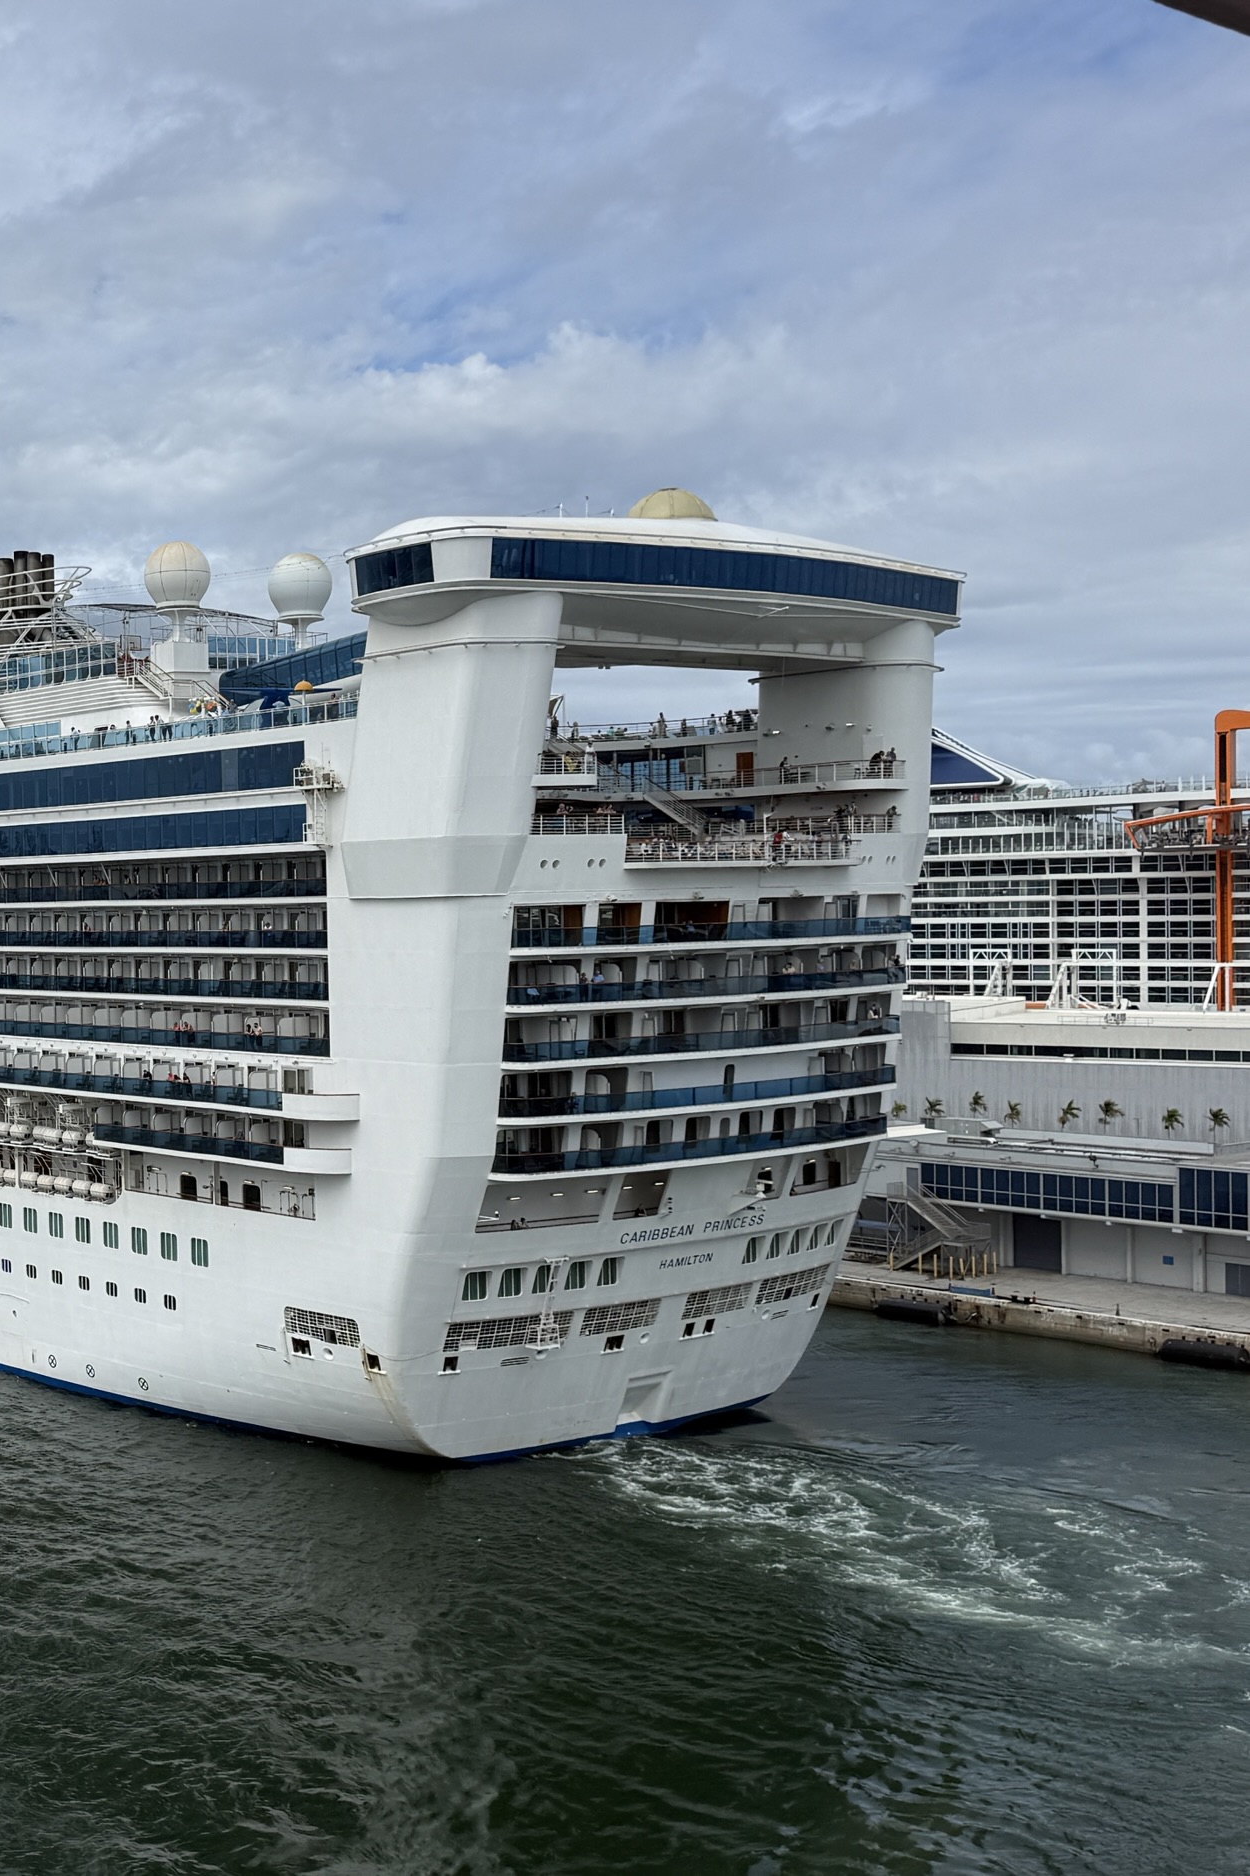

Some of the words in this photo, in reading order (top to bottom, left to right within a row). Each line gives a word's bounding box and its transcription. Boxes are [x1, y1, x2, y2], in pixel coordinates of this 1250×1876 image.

[620, 1224, 695, 1244] CARIBBEAN
[703, 1214, 765, 1233] PRINCESS
[658, 1252, 714, 1270] HAMILTON
